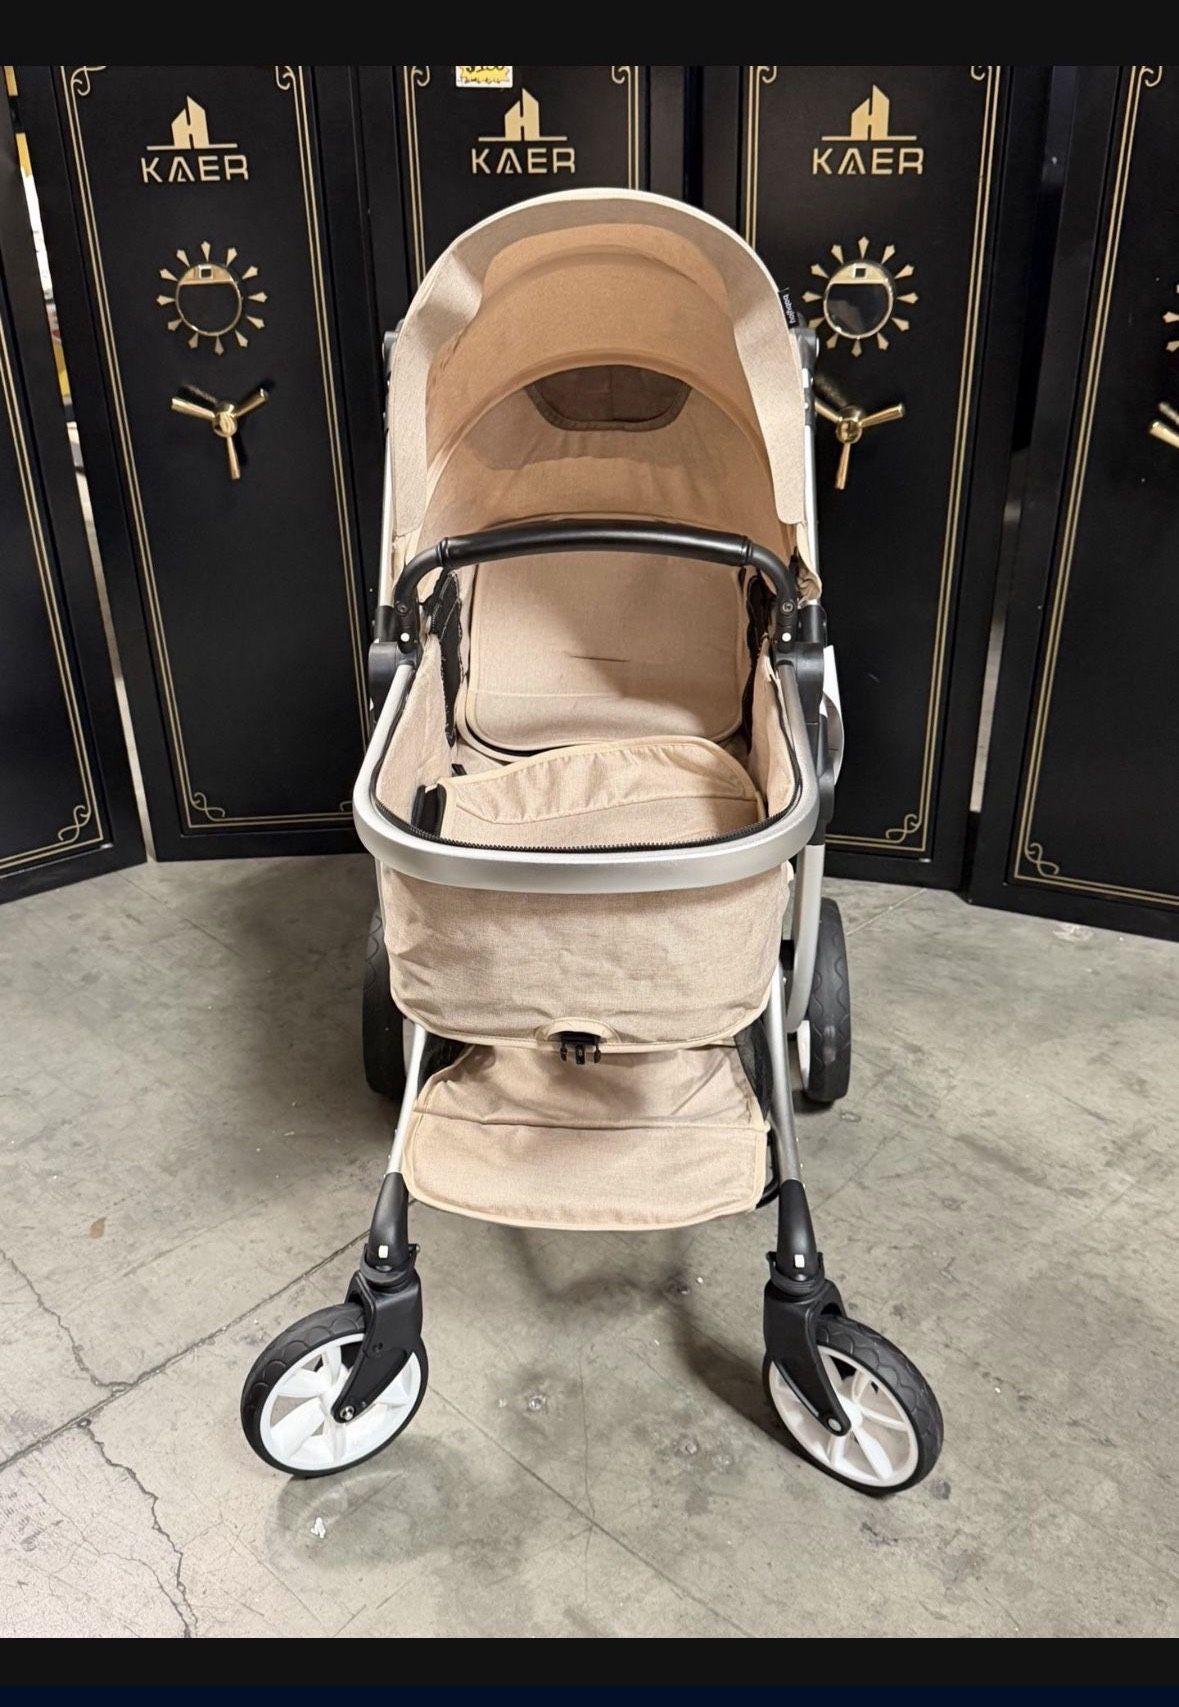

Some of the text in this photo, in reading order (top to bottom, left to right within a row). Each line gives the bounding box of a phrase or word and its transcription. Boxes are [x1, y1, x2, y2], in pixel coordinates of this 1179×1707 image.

[141, 155, 249, 183] KAER
[471, 147, 576, 174] KAER
[812, 147, 924, 175] KAER
